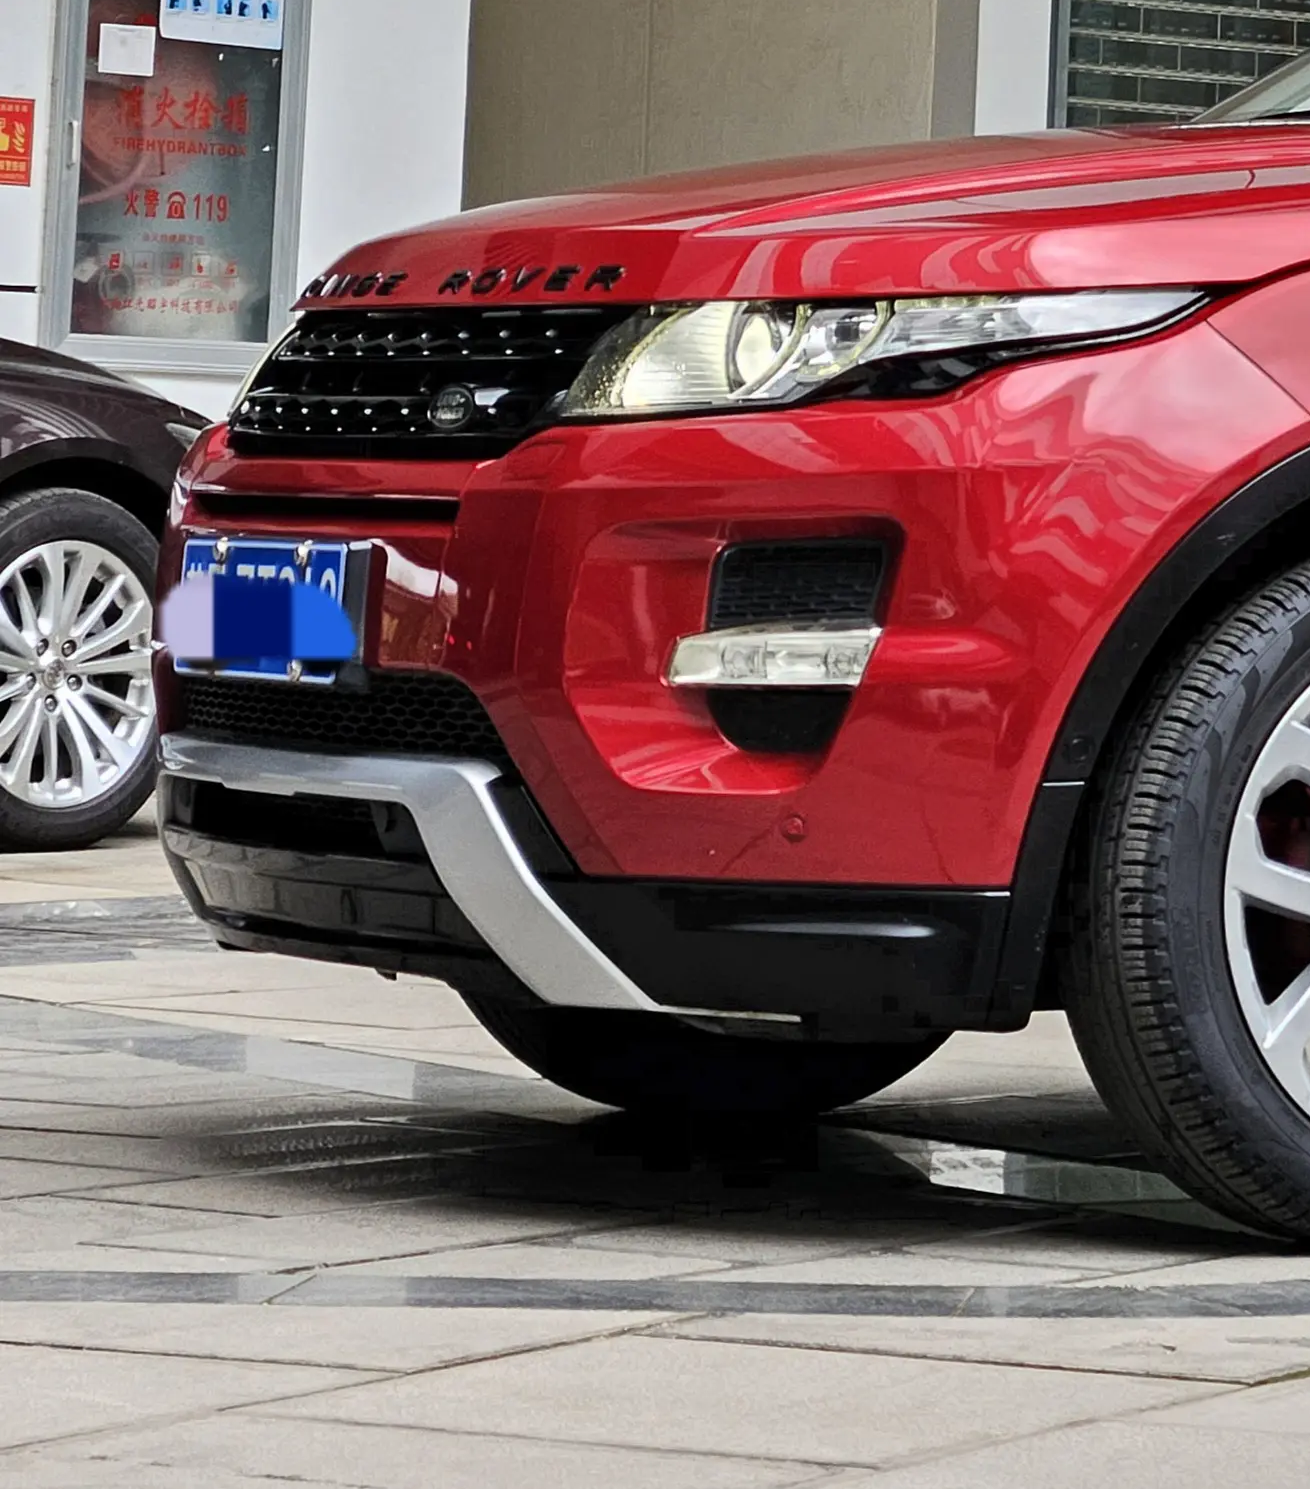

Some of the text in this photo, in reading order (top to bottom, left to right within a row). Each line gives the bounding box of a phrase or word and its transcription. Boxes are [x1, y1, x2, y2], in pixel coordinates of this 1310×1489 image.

[123, 188, 229, 222] 火警 119
[438, 264, 627, 295] ROVER
